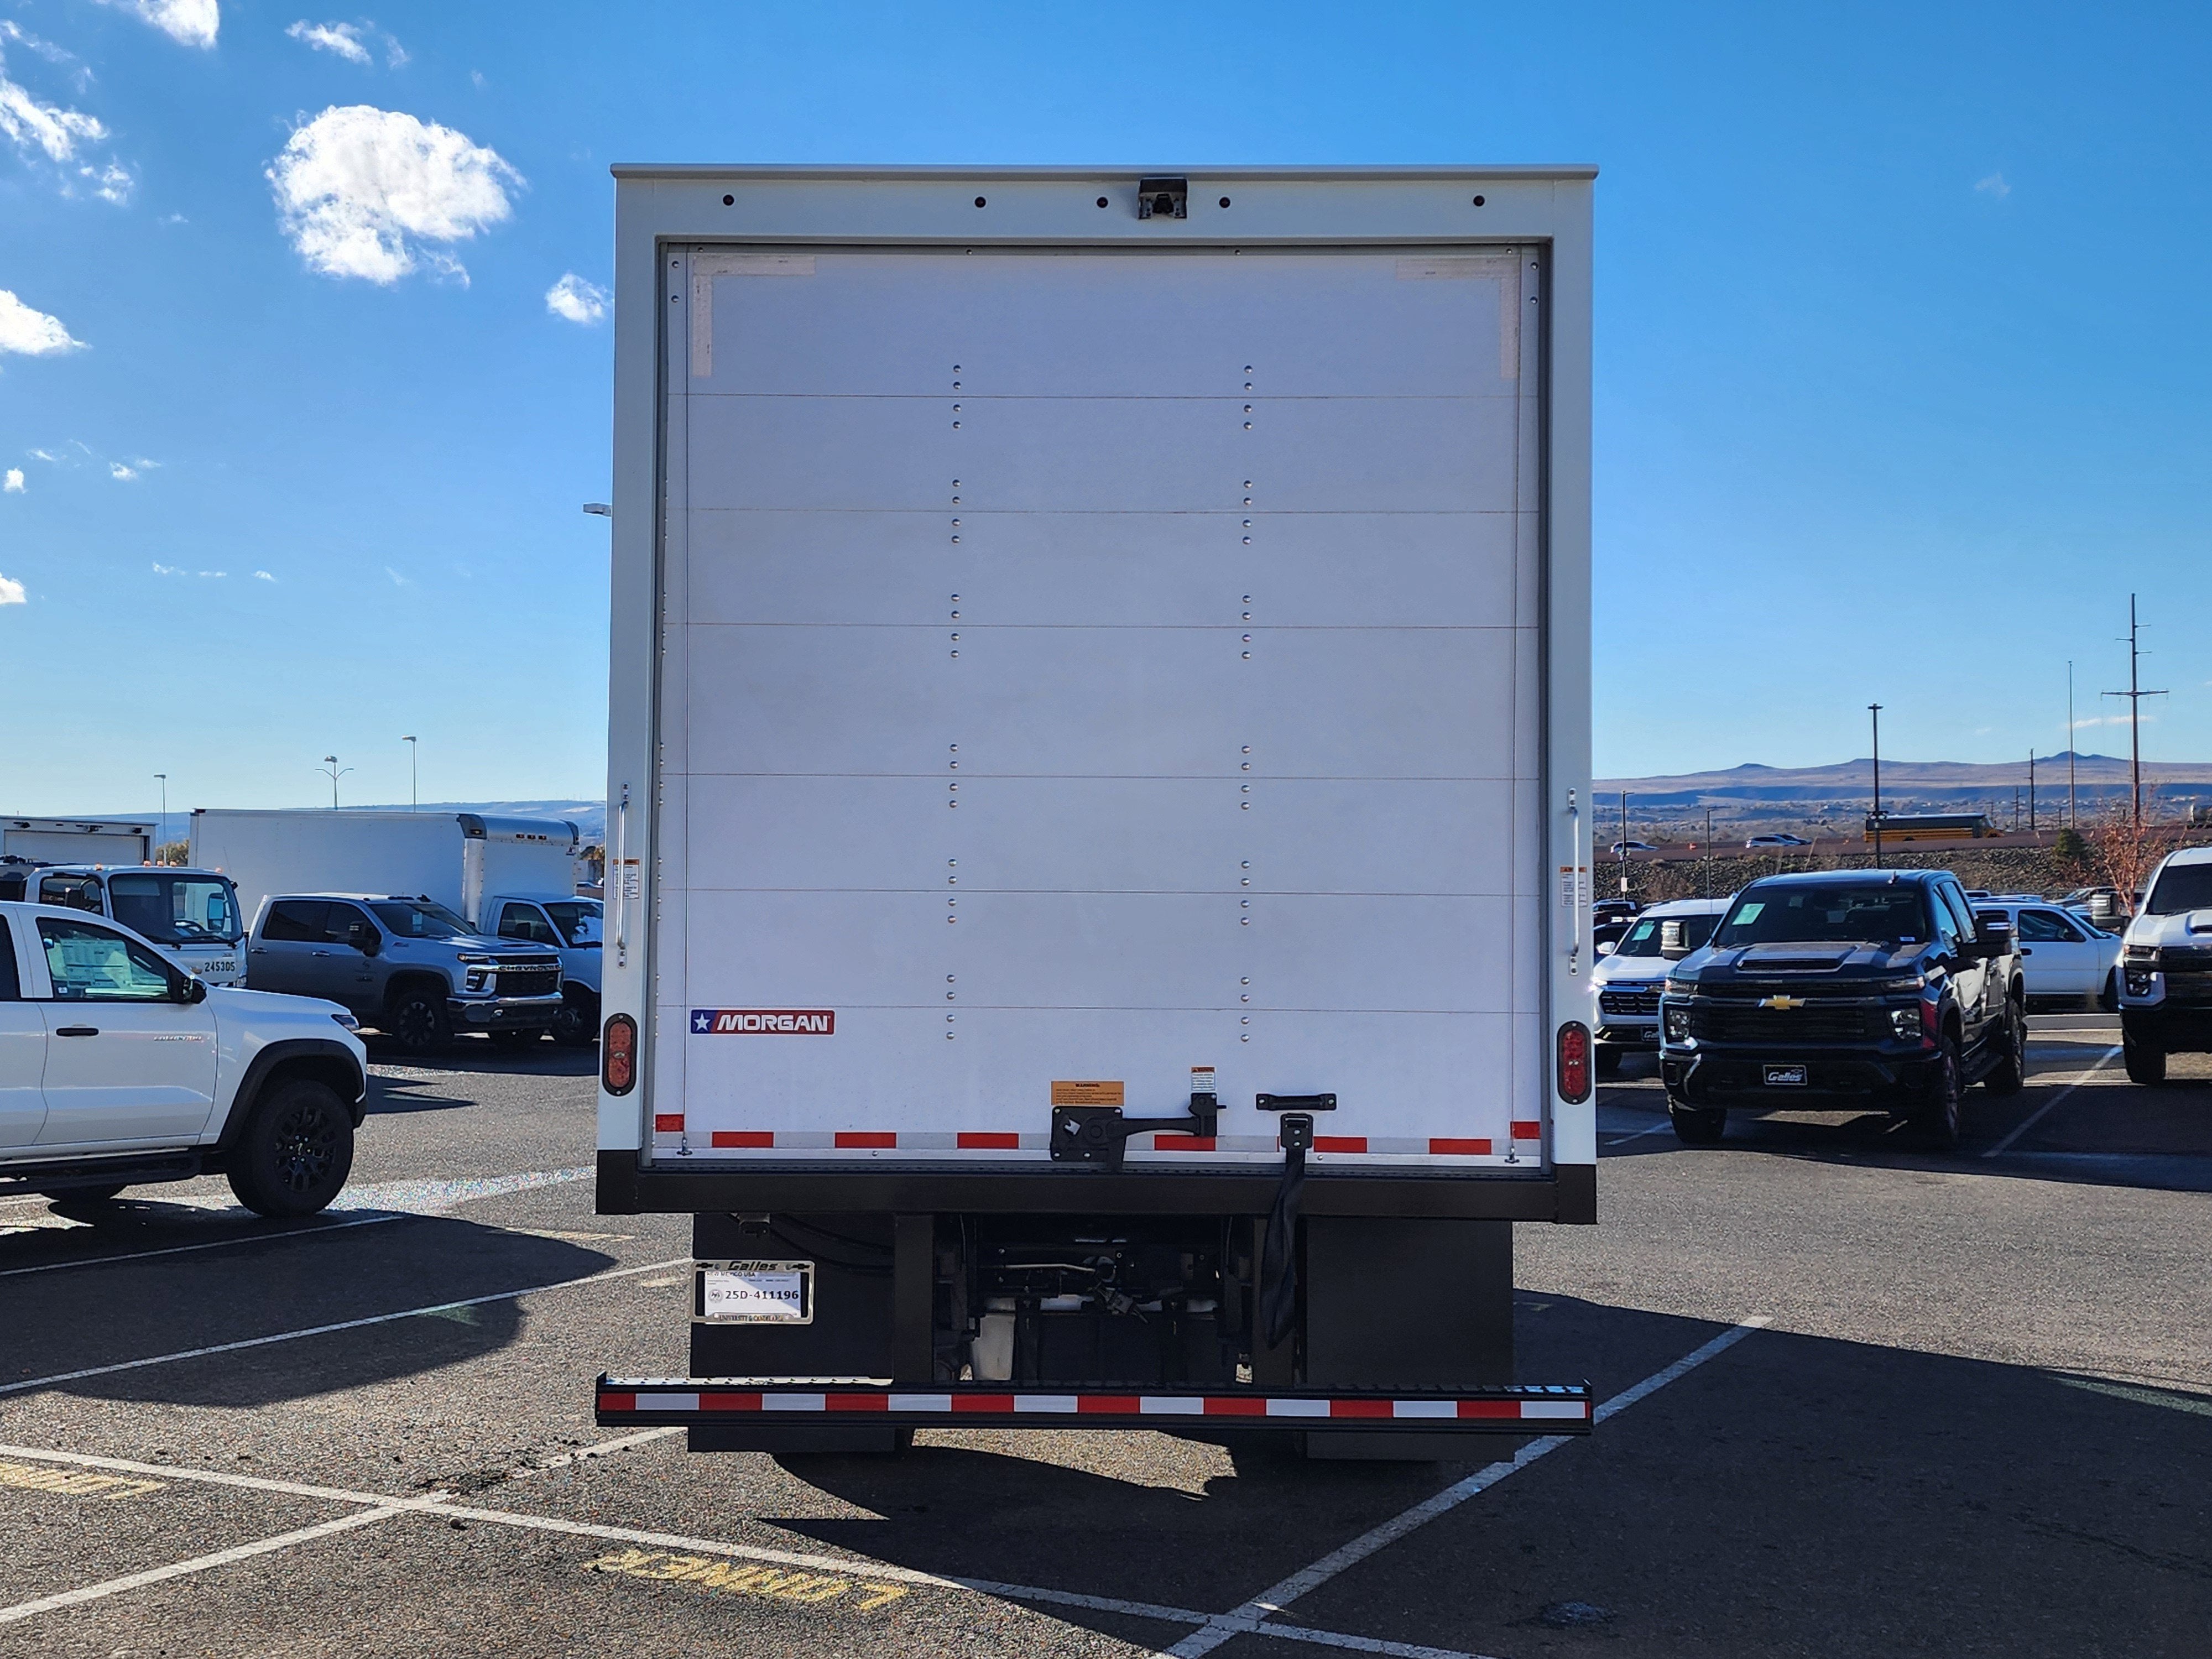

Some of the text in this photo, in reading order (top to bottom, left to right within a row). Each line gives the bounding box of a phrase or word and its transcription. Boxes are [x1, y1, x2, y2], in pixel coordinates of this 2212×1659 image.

[205, 961, 235, 972] 245305
[717, 1014, 827, 1031] MORGAN
[1768, 1072, 1803, 1081] Galles
[727, 1261, 778, 1271] Galles
[725, 1290, 799, 1300] 25D-411196
